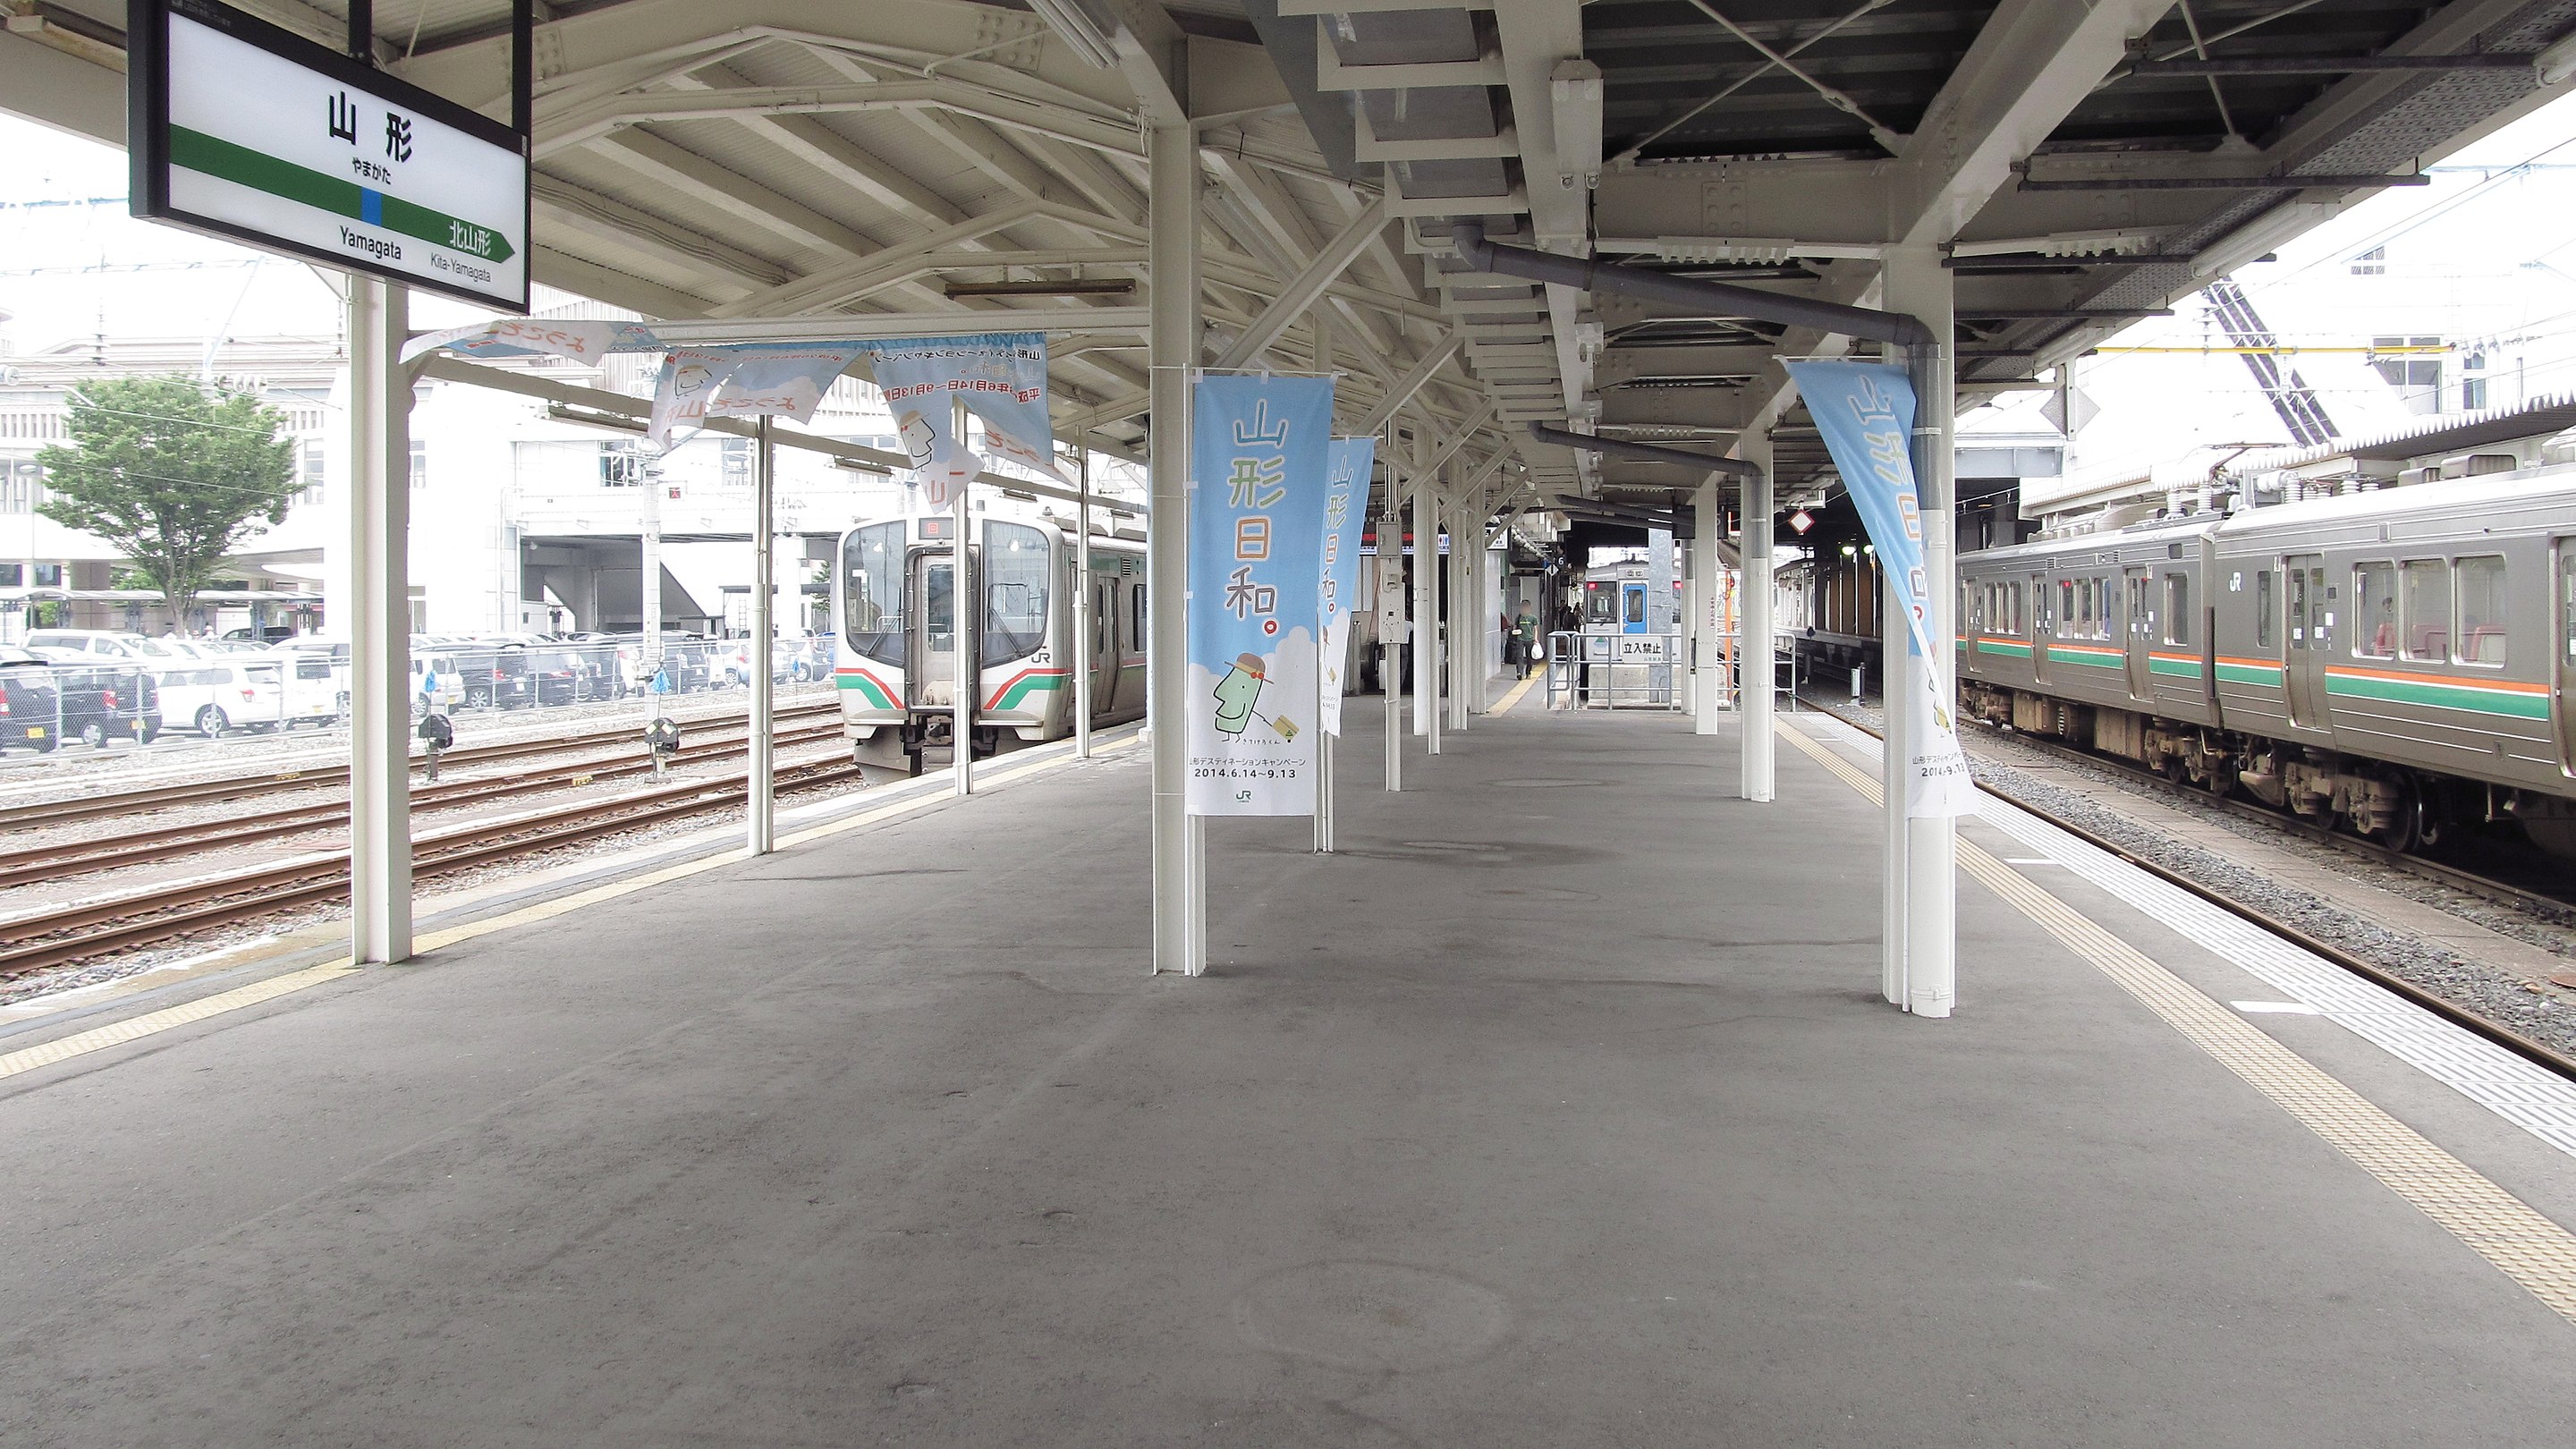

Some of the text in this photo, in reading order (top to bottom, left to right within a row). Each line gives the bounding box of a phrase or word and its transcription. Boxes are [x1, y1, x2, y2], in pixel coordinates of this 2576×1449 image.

[329, 91, 412, 163] 山形
[352, 157, 392, 185] やまがた
[339, 225, 402, 260] Yamagata
[449, 219, 492, 258] 北山形
[430, 251, 491, 283] Kita-Yamagata
[1227, 399, 1288, 635] 山形日和。
[1321, 454, 1354, 614] 山形日和。
[1558, 556, 1564, 565] 6
[2229, 572, 2241, 591] JR
[1031, 653, 1051, 664] JR
[1623, 642, 1662, 654] 立入禁止
[1236, 790, 1252, 801] JR
